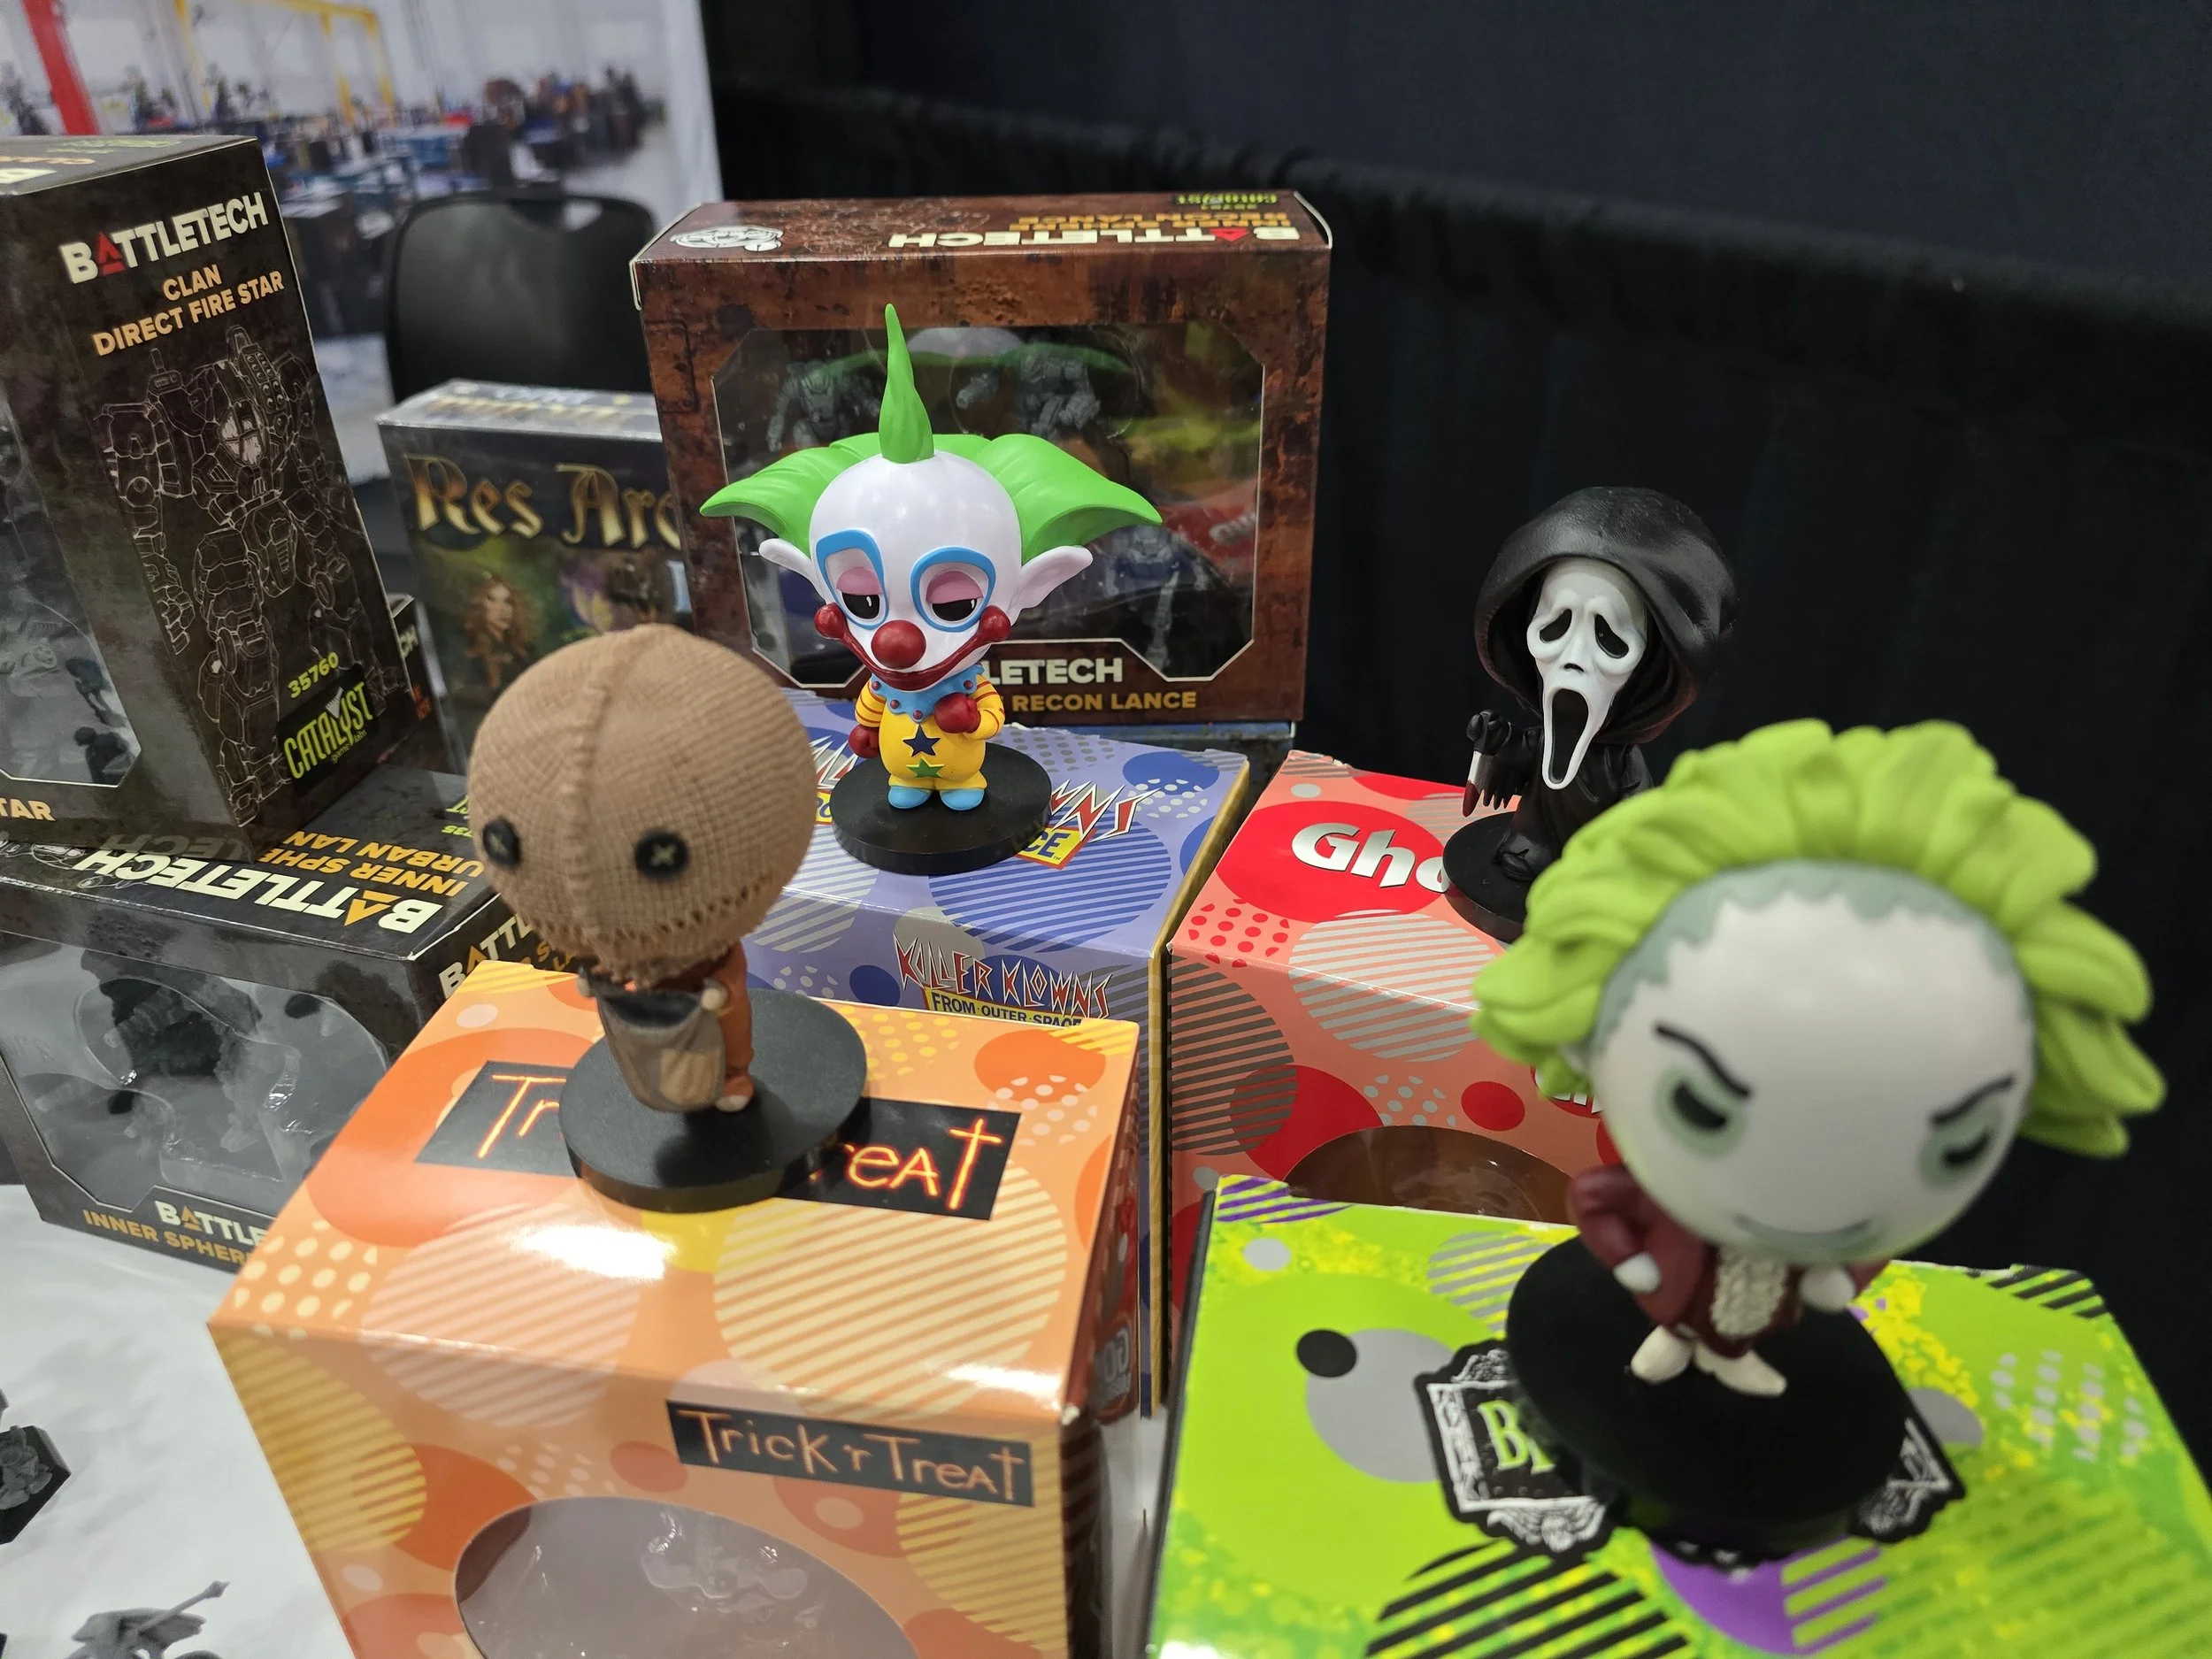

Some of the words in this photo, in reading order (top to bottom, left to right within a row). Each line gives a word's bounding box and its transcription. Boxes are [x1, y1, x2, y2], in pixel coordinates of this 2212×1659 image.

[59, 191, 269, 284] BATTLETECH
[888, 227, 1300, 248] BATTLETECH
[162, 265, 223, 302] CLAN
[92, 307, 183, 356] DIRECT
[188, 291, 236, 325] FIRE
[239, 271, 285, 306] STAR
[403, 452, 544, 540] Res
[288, 651, 339, 699] 35760
[1012, 693, 1102, 712] RECON
[1110, 691, 1197, 710] LANCE
[284, 681, 373, 780] CATALYST
[349, 862, 469, 897] INNER
[356, 841, 485, 878] URBAN
[72, 849, 443, 934] BATTLETECH
[893, 931, 995, 1001] KILLER
[1001, 958, 1114, 1020] KLOWNS
[931, 991, 976, 1015] FROM
[980, 1005, 1028, 1023] OUTER
[82, 1209, 161, 1243] INNER
[164, 1230, 250, 1267] SPHER
